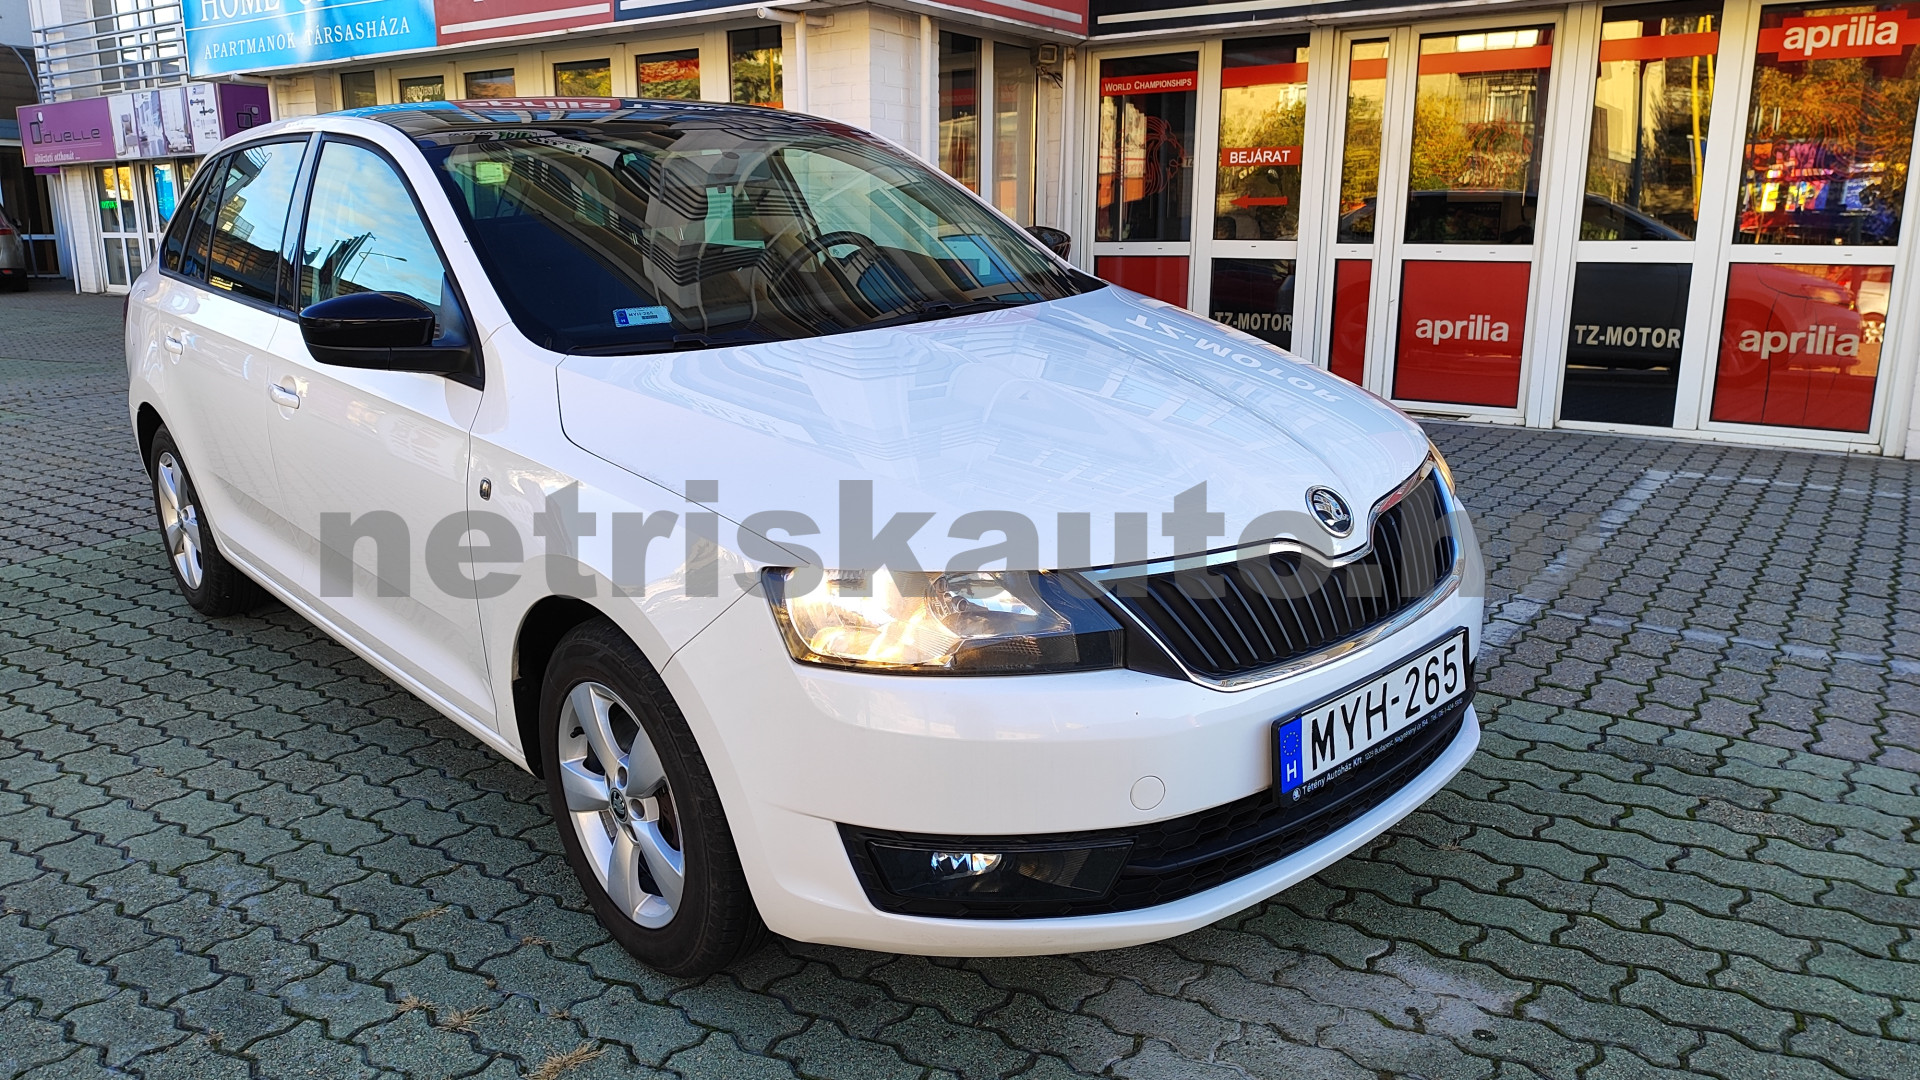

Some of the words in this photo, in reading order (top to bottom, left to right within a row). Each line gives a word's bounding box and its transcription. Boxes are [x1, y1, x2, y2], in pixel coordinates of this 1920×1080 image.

[204, 32, 296, 60] APARTMANOK
[304, 16, 410, 46] TÁRSASHÁZA
[1783, 15, 1899, 56] aprilia
[1229, 148, 1291, 164] BEJÁRAT
[1214, 312, 1293, 332] TZ-MOTOR
[1415, 314, 1510, 345] aprilia
[1574, 324, 1681, 349] TZ-MOTOR
[1738, 325, 1860, 360] aprilia
[1311, 645, 1458, 771] MYH-265
[1287, 759, 1297, 783] H
[1302, 777, 1325, 795] Tétény
[1326, 762, 1352, 782] Autóház
